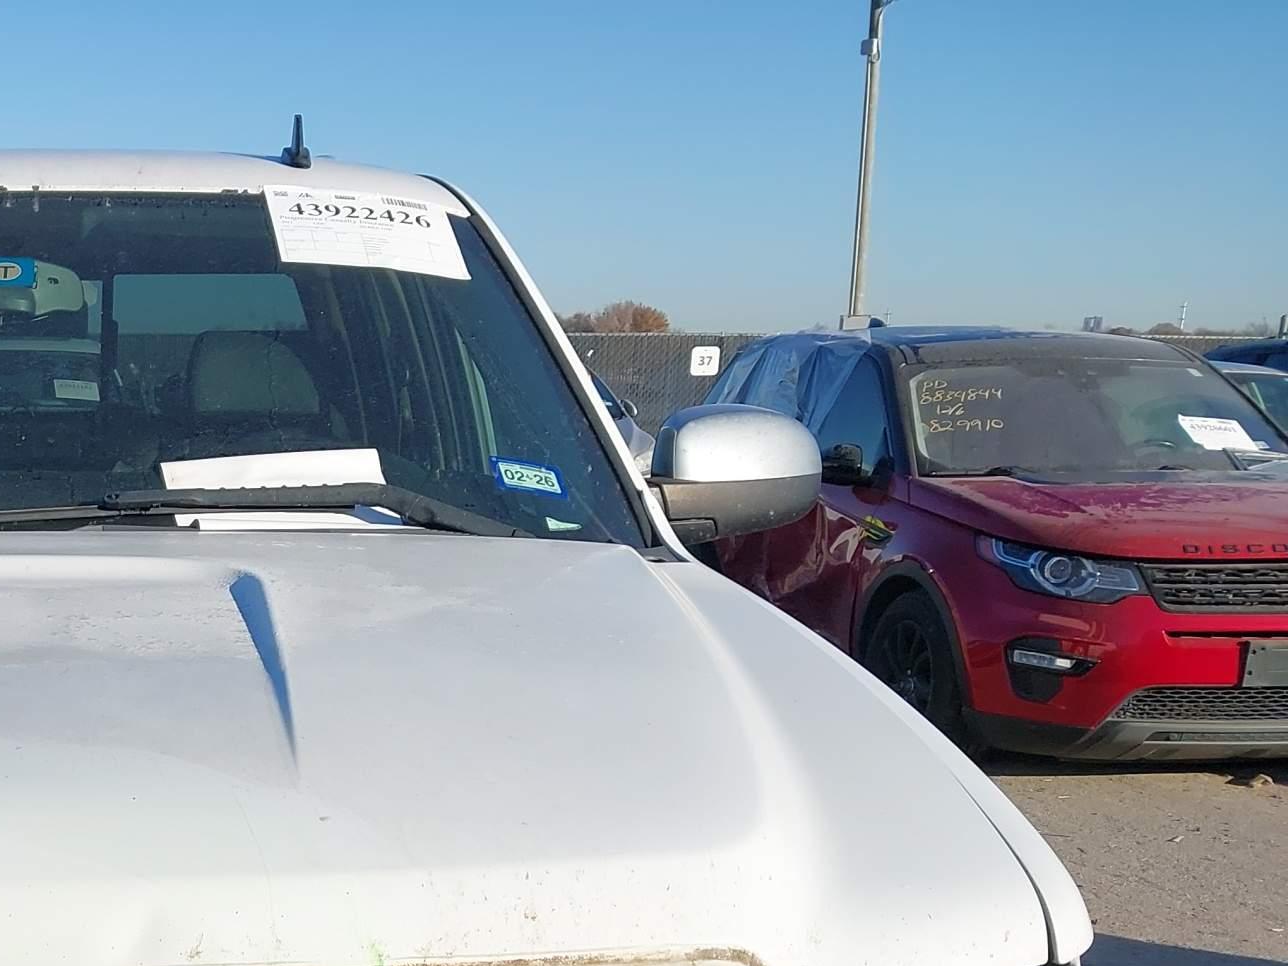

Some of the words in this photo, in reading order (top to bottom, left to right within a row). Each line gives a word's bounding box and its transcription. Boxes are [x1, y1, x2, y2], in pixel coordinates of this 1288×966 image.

[288, 202, 431, 228] 43922426
[697, 355, 713, 366] 37
[922, 380, 948, 392] PD
[930, 419, 1004, 432] 829910
